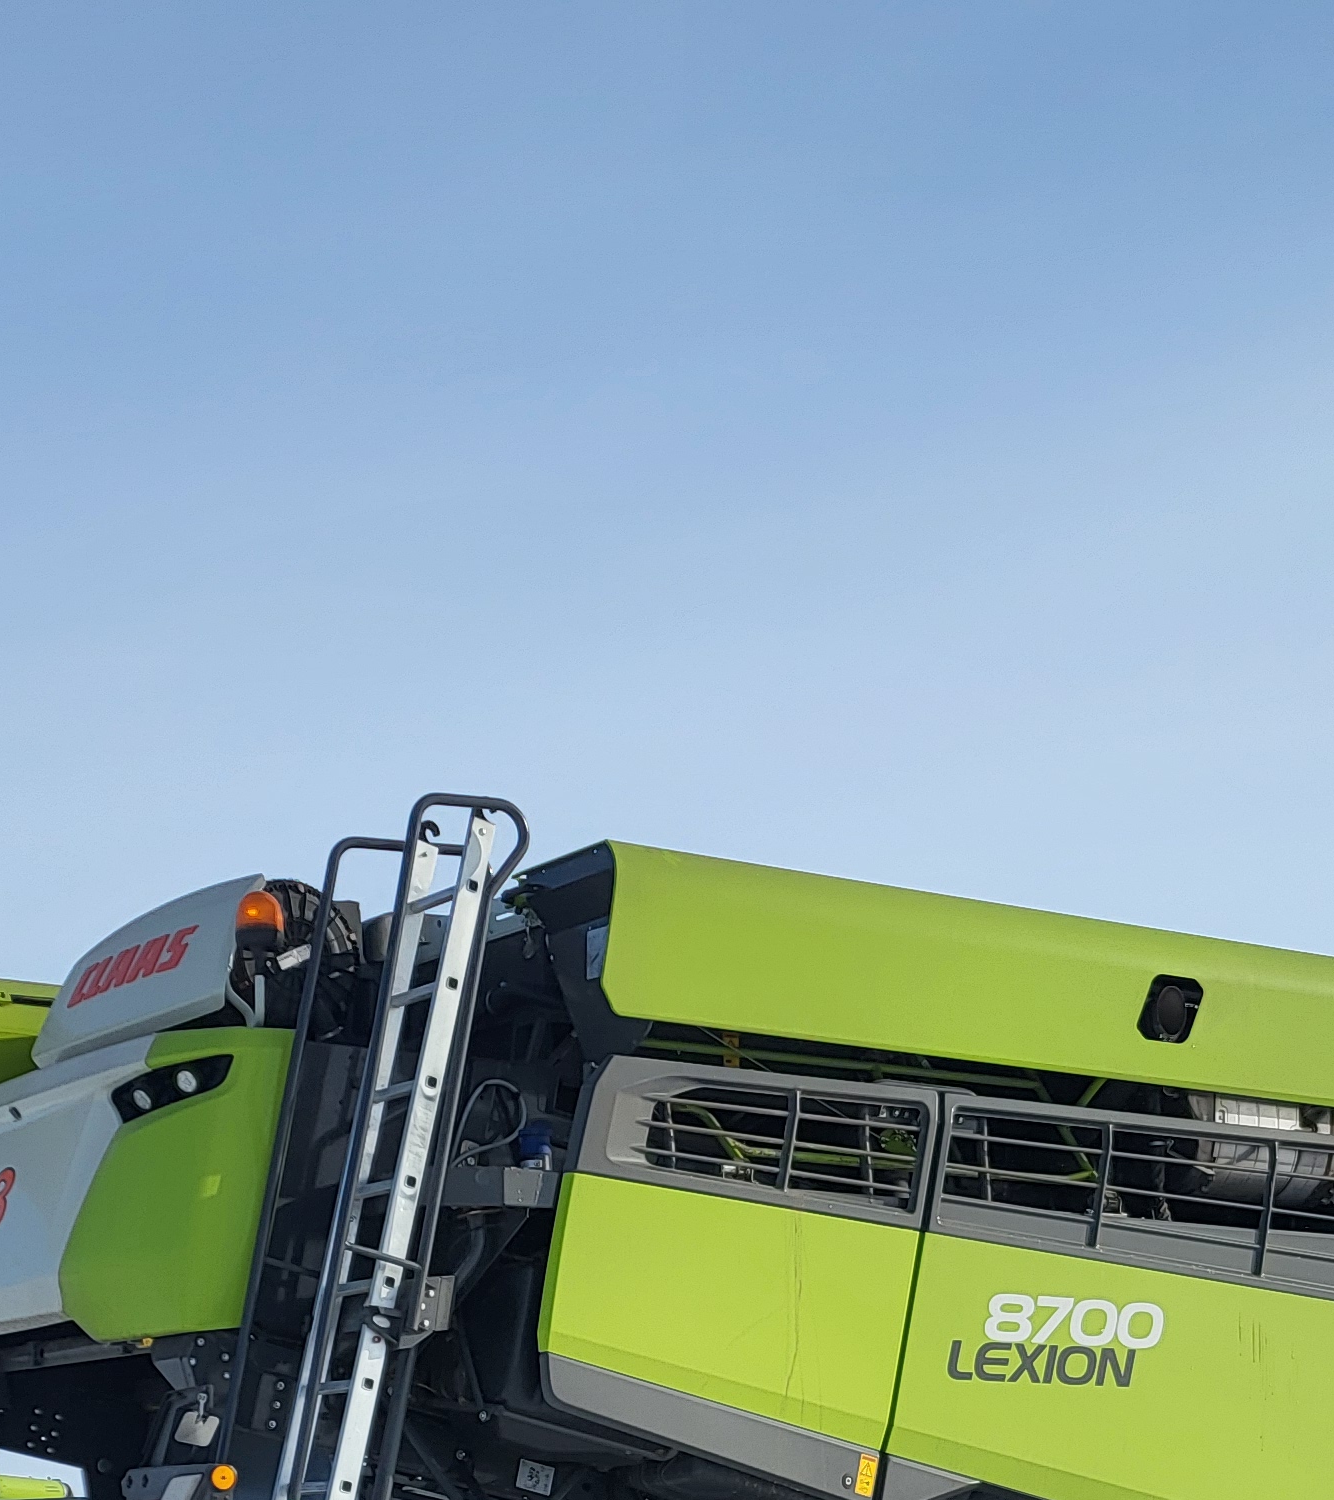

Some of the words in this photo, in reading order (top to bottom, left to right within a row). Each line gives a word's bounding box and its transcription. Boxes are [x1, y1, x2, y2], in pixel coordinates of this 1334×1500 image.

[66, 924, 200, 1009] CLAAS
[984, 1293, 1165, 1350] 8700
[946, 1339, 1137, 1388] LEXION
